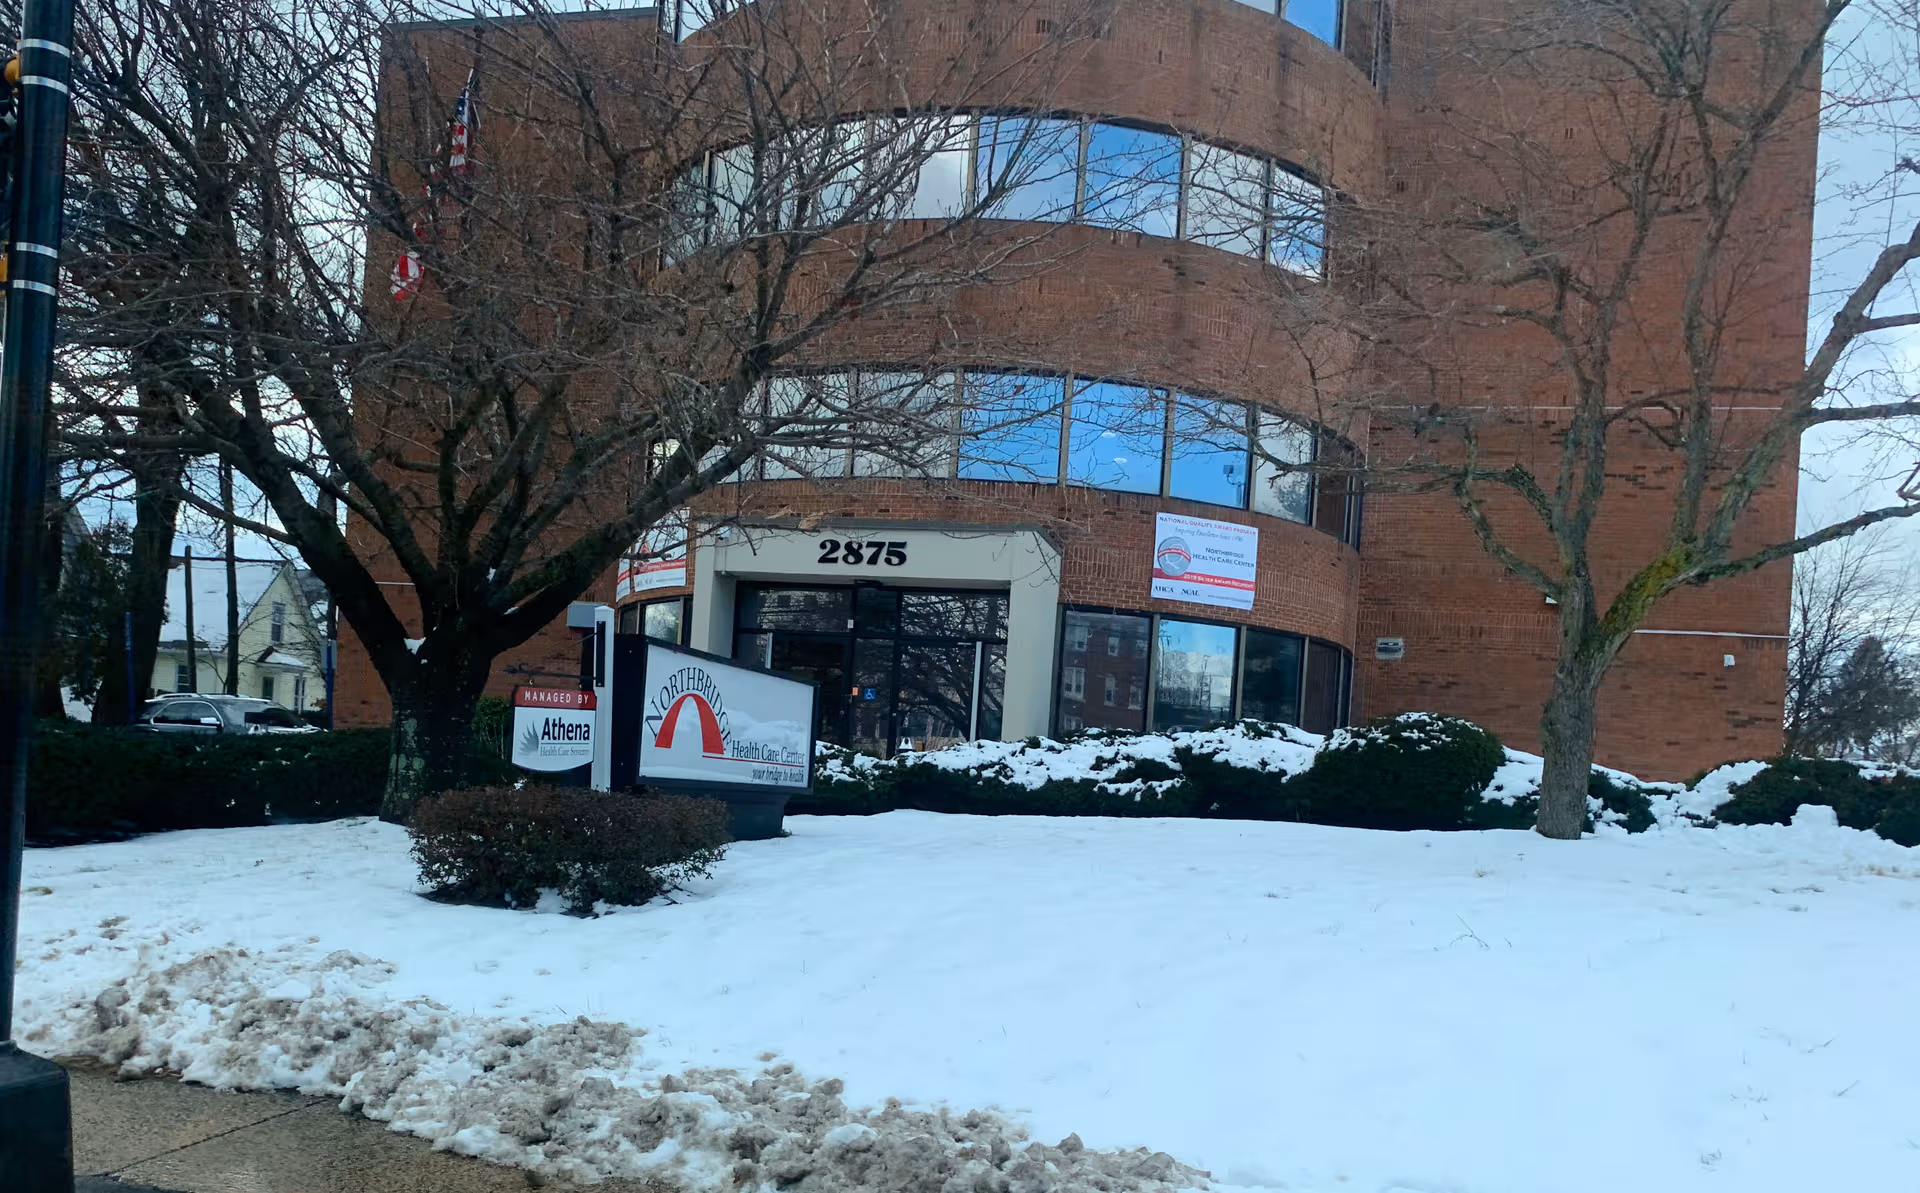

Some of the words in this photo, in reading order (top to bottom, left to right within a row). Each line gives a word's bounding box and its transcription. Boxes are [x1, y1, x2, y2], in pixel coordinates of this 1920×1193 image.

[1159, 516, 1188, 525] NATIONAL
[1189, 520, 1213, 529] QUALITY
[817, 538, 908, 567] 2875
[1180, 588, 1200, 597] NCAL
[524, 690, 571, 703] MANAGED
[577, 694, 589, 705] BY
[644, 667, 733, 751] NORTHBRIDGE
[541, 716, 591, 741] Athena
[732, 740, 760, 760] Health
[761, 743, 780, 763] Care
[780, 746, 805, 765] Center
[751, 768, 766, 782] your
[766, 765, 783, 784] bridge
[783, 769, 789, 782] to
